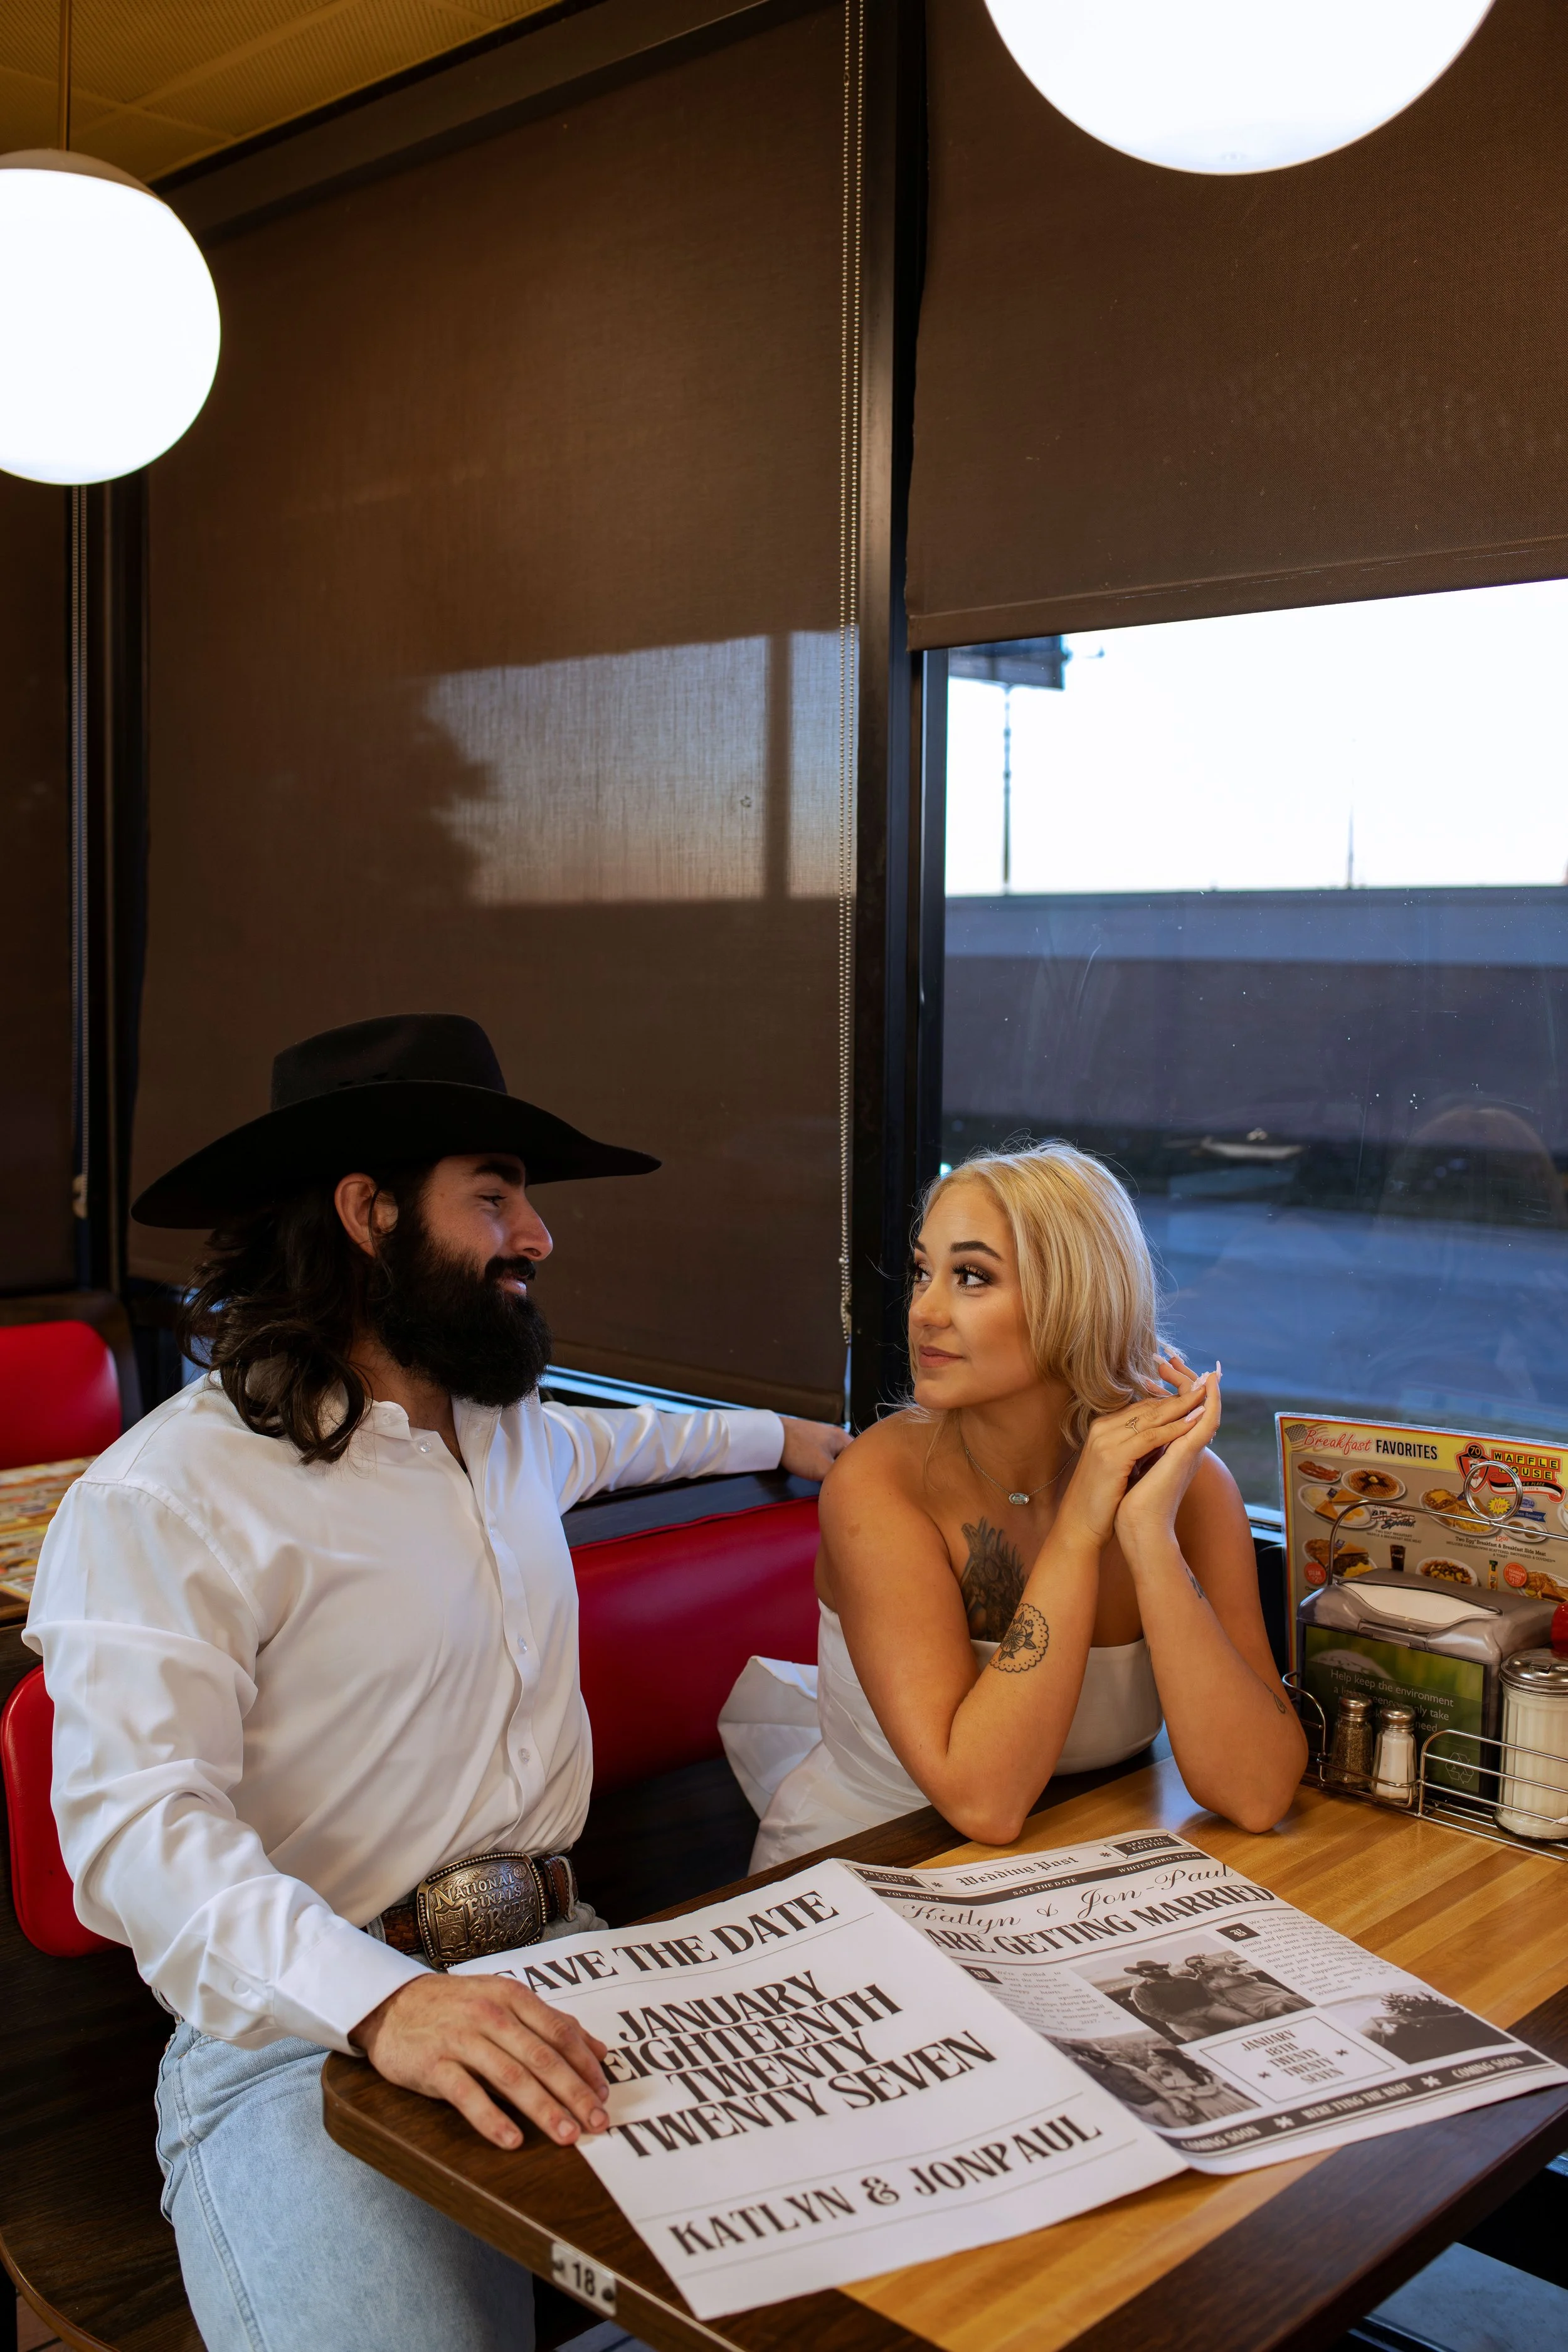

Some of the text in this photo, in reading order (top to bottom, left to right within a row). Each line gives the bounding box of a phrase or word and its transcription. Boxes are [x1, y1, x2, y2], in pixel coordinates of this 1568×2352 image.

[1304, 1429, 1438, 1459] Breakfast FAVORITES
[1470, 1447, 1481, 1455] 70
[1494, 1452, 1558, 1468] WAFFLE
[1476, 1539, 1497, 1547] Breakfast
[1503, 1544, 1523, 1552] Breakfast
[1331, 1669, 1352, 1682] Help
[1354, 1675, 1375, 1690] keep
[1379, 1681, 1393, 1692] the
[1396, 1687, 1454, 1707] environment
[1430, 1710, 1449, 1720] take
[1126, 1837, 1165, 1848] SPECIAL
[1131, 1841, 1170, 1851] EDITION
[862, 1870, 911, 1881] BREAKING
[956, 1856, 1079, 1887] Wedding Post
[1118, 1857, 1175, 1873] WHITESBORO,
[432, 1873, 515, 1911] NATIONAL
[1012, 1878, 1077, 1896] SAVE THE DATE
[465, 1885, 521, 1921] FINALS
[440, 1913, 462, 1925] NFR
[487, 1897, 536, 1936] RODEO
[903, 1904, 1020, 1934] Katlyn
[924, 1885, 1275, 1956] ARE GETTING MARRIED
[494, 1890, 839, 1993] AVE THE DATE
[1242, 1940, 1261, 1949] family
[1250, 1945, 1271, 1953] invited
[1258, 1949, 1283, 1958] occasion
[617, 1970, 827, 2042] JANUARY
[600, 1983, 904, 2085] EIGHTEENTH
[1241, 2030, 1296, 2051] JANUARY
[1265, 2042, 1299, 2056] 18TH
[1266, 2048, 1320, 2067] TWENTY
[666, 2030, 880, 2104] TWENTY
[1280, 2057, 1335, 2077] TWENTY
[1300, 2068, 1345, 2085] SEVEN
[1451, 2056, 1524, 2079] COMING SOON
[605, 2030, 997, 2157] TWENTY SEVEN
[1330, 2095, 1365, 2111] TYING
[1360, 2090, 1386, 2102] THE
[1381, 2082, 1412, 2097] KNOT
[1180, 2125, 1261, 2151] COMING SOON
[668, 2186, 856, 2256] KATLYN
[861, 2176, 900, 2206] &
[572, 2261, 596, 2297] 18
